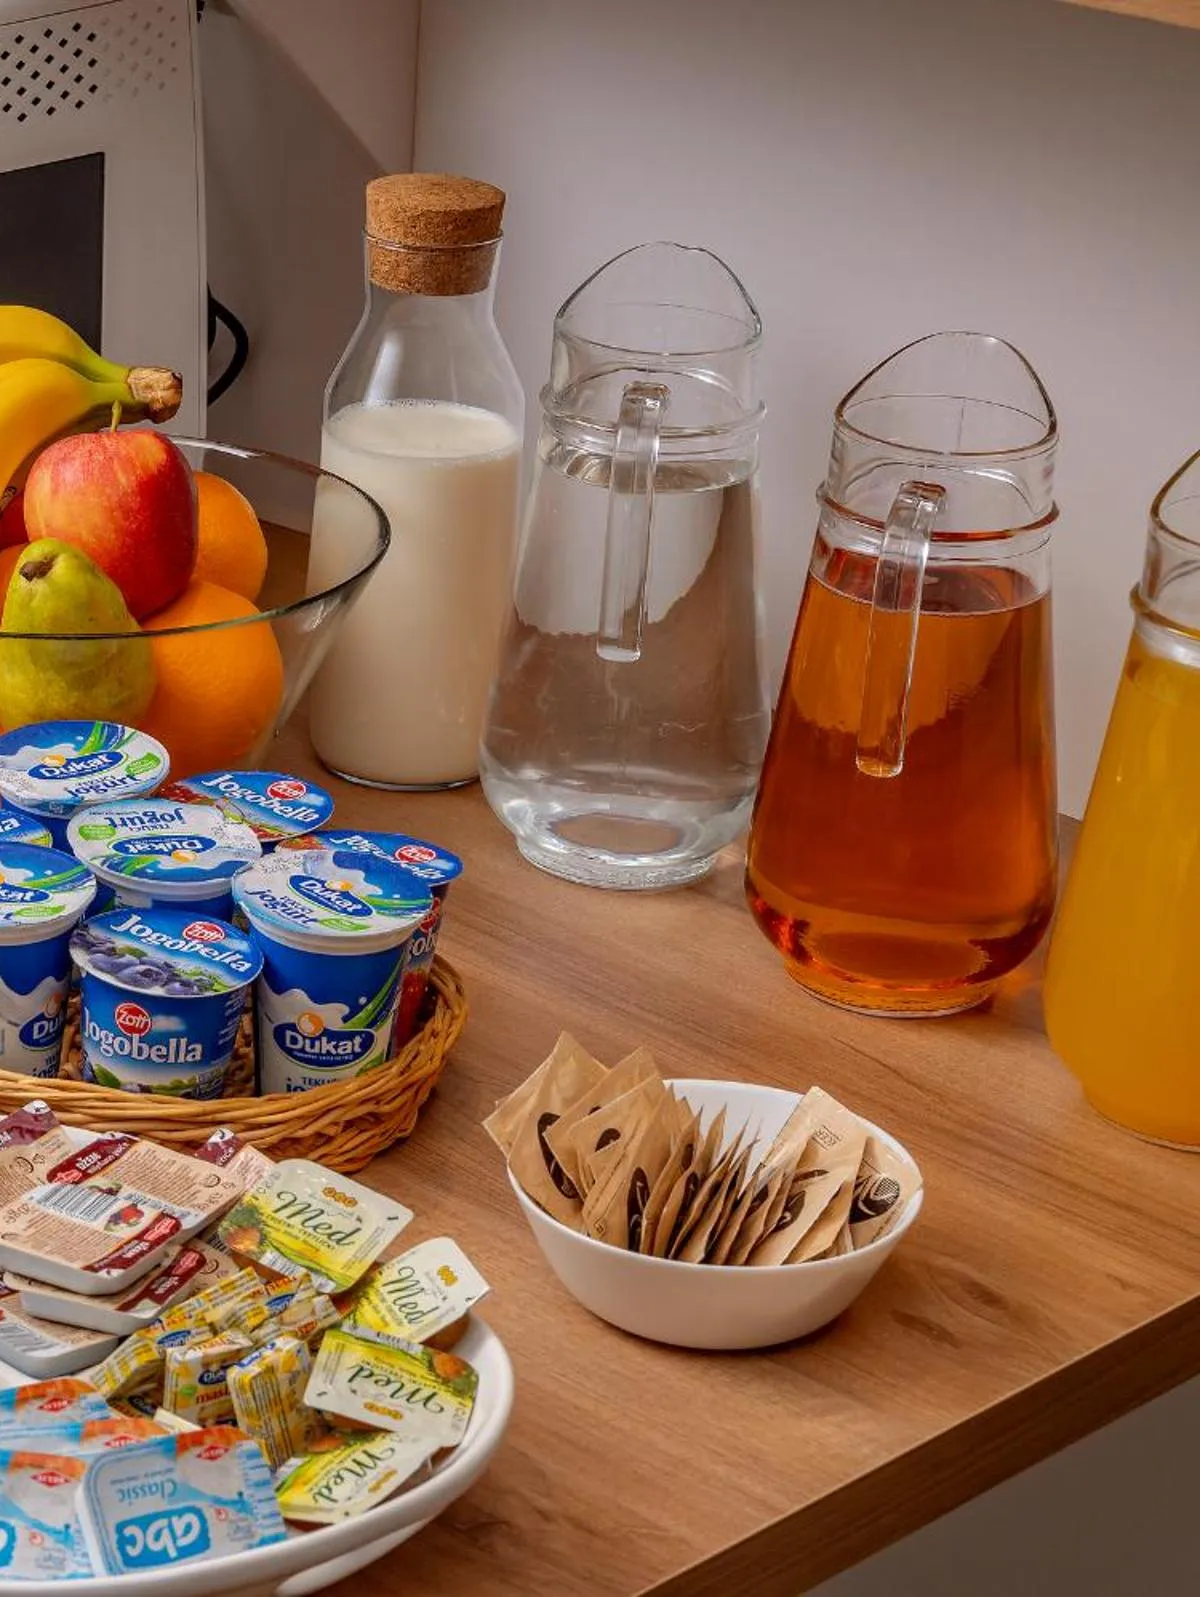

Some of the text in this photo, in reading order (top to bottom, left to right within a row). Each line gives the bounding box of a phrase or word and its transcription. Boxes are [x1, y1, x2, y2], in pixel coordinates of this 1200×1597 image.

[40, 753, 114, 778] Dukat
[201, 773, 320, 823] Jogobella
[124, 839, 204, 854] Dukat
[299, 879, 364, 912] Dukat
[109, 914, 253, 974] Jogobella
[118, 1008, 151, 1030] Zott
[284, 1029, 364, 1056] Dukat
[272, 1190, 363, 1247] Med
[381, 1265, 441, 1325] Med
[346, 1363, 446, 1415] Med
[116, 1476, 179, 1508] Classic
[311, 1446, 397, 1505] Med
[122, 1511, 201, 1559] abc
